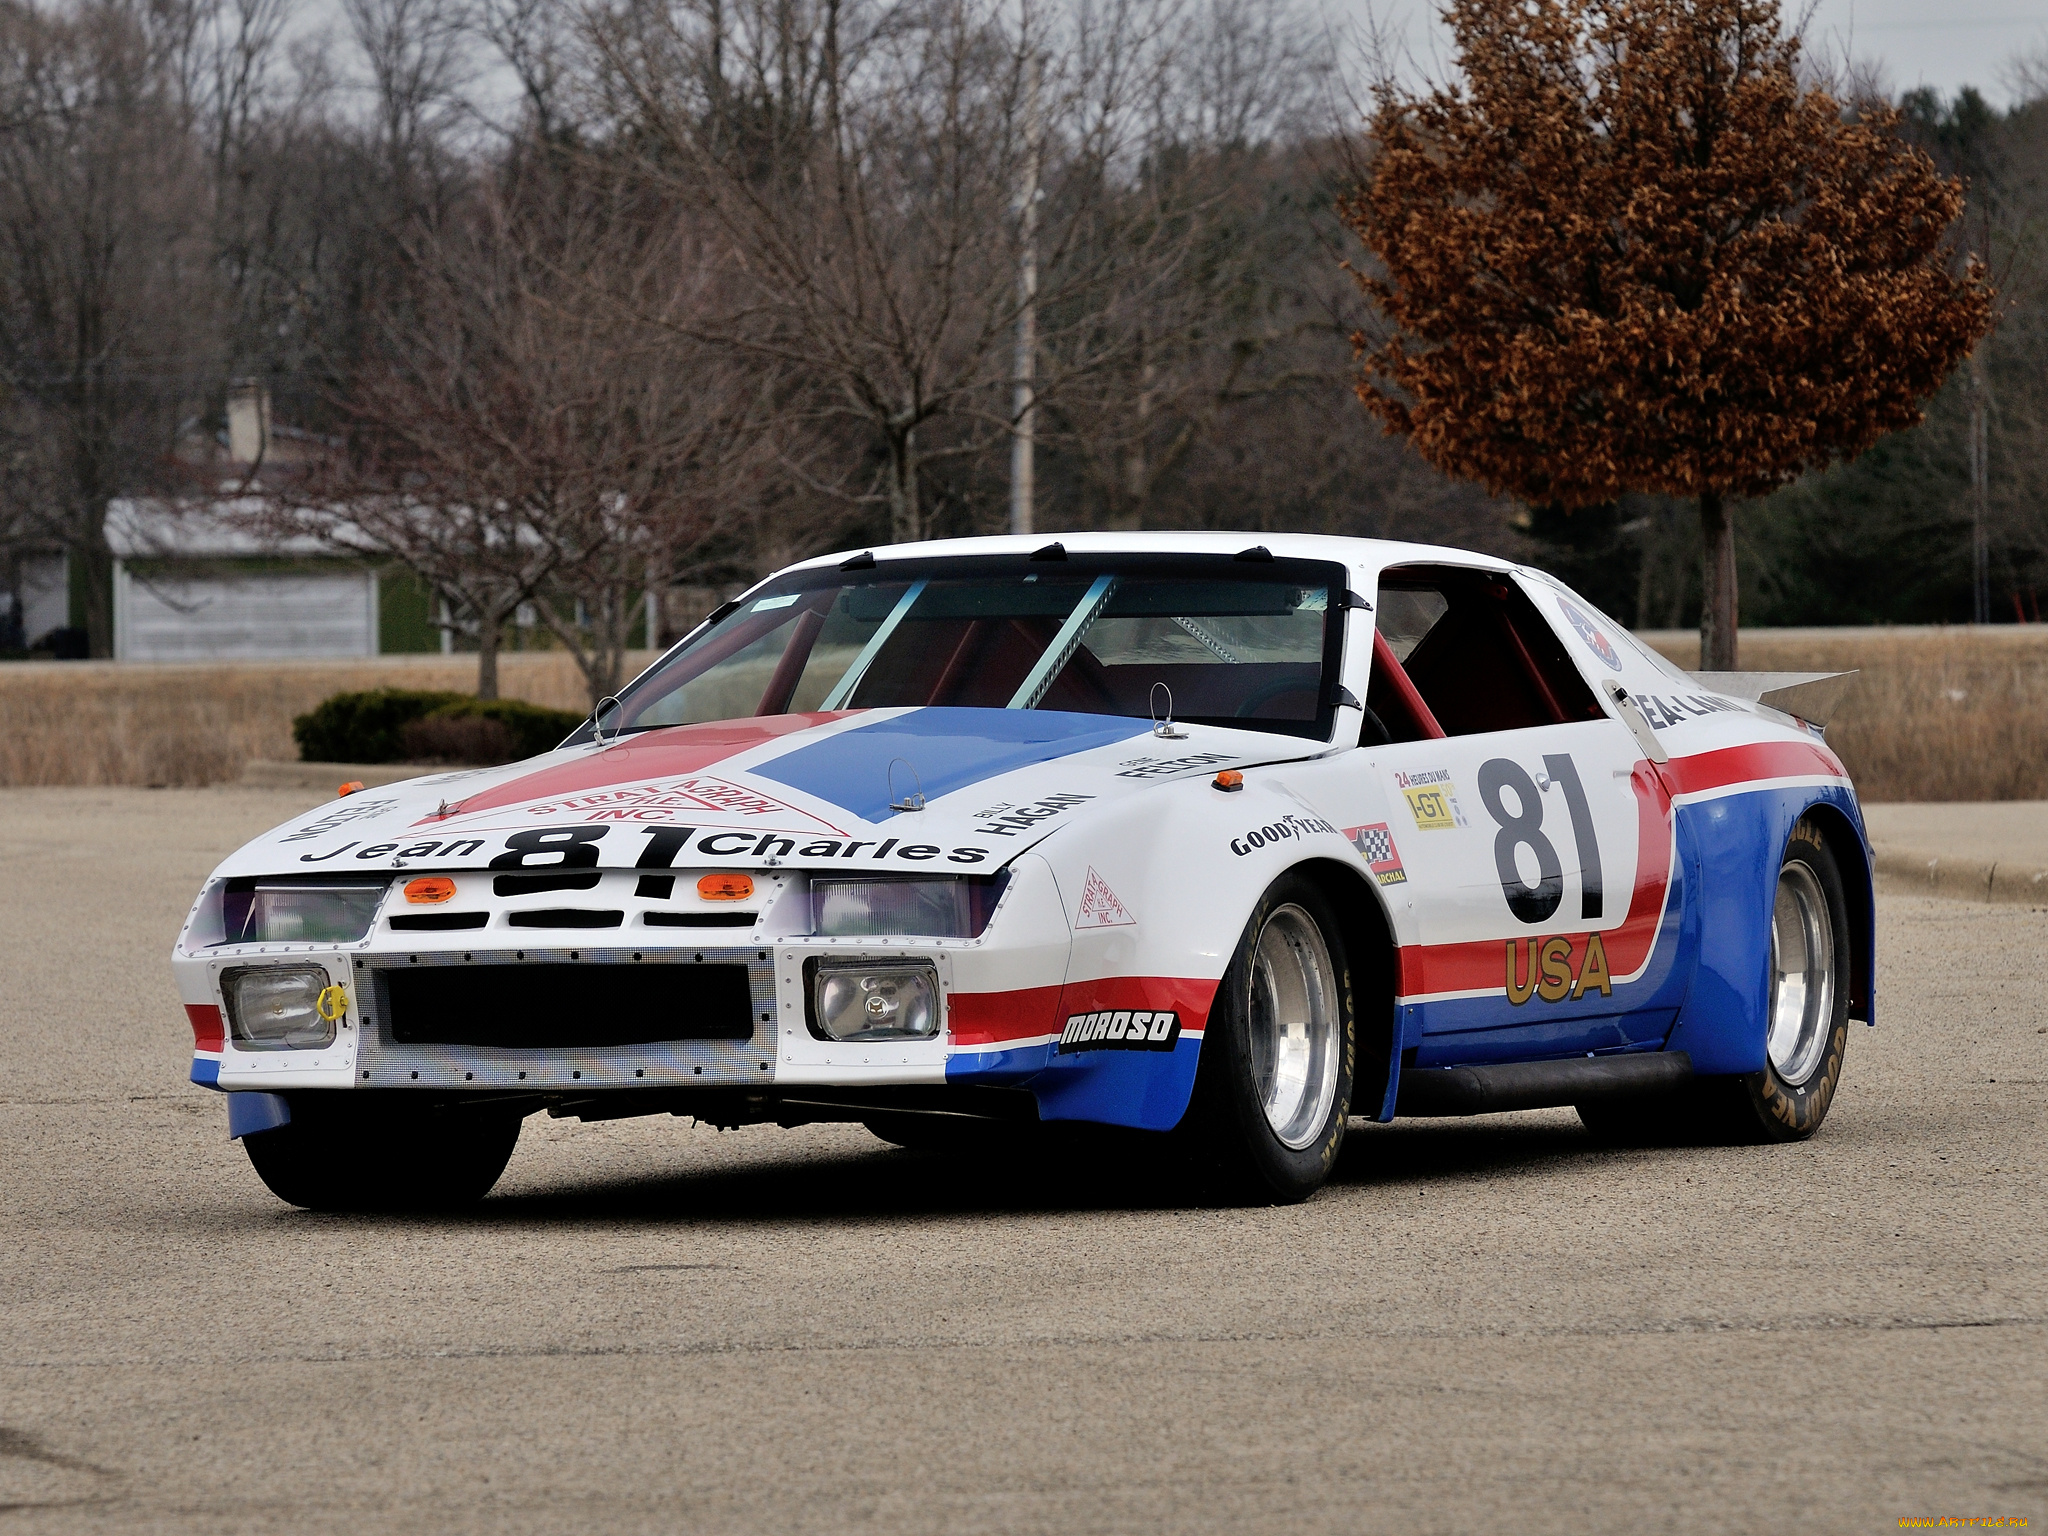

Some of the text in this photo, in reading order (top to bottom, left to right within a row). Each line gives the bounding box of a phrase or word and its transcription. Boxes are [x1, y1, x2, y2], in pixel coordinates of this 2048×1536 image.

[1114, 752, 1241, 779] FELTON
[1394, 771, 1411, 788] 24
[1427, 771, 1437, 783] DU
[1434, 769, 1451, 782] MANS
[585, 809, 676, 821] INC.
[972, 801, 1016, 820] BILLY
[974, 793, 1098, 837] HAGAN
[1406, 792, 1445, 818] I-GT
[1477, 753, 1604, 924] 81
[300, 824, 990, 900] Jean 81 Charles
[1505, 931, 1613, 1007] USA
[1060, 1011, 1175, 1044] MOROSO
